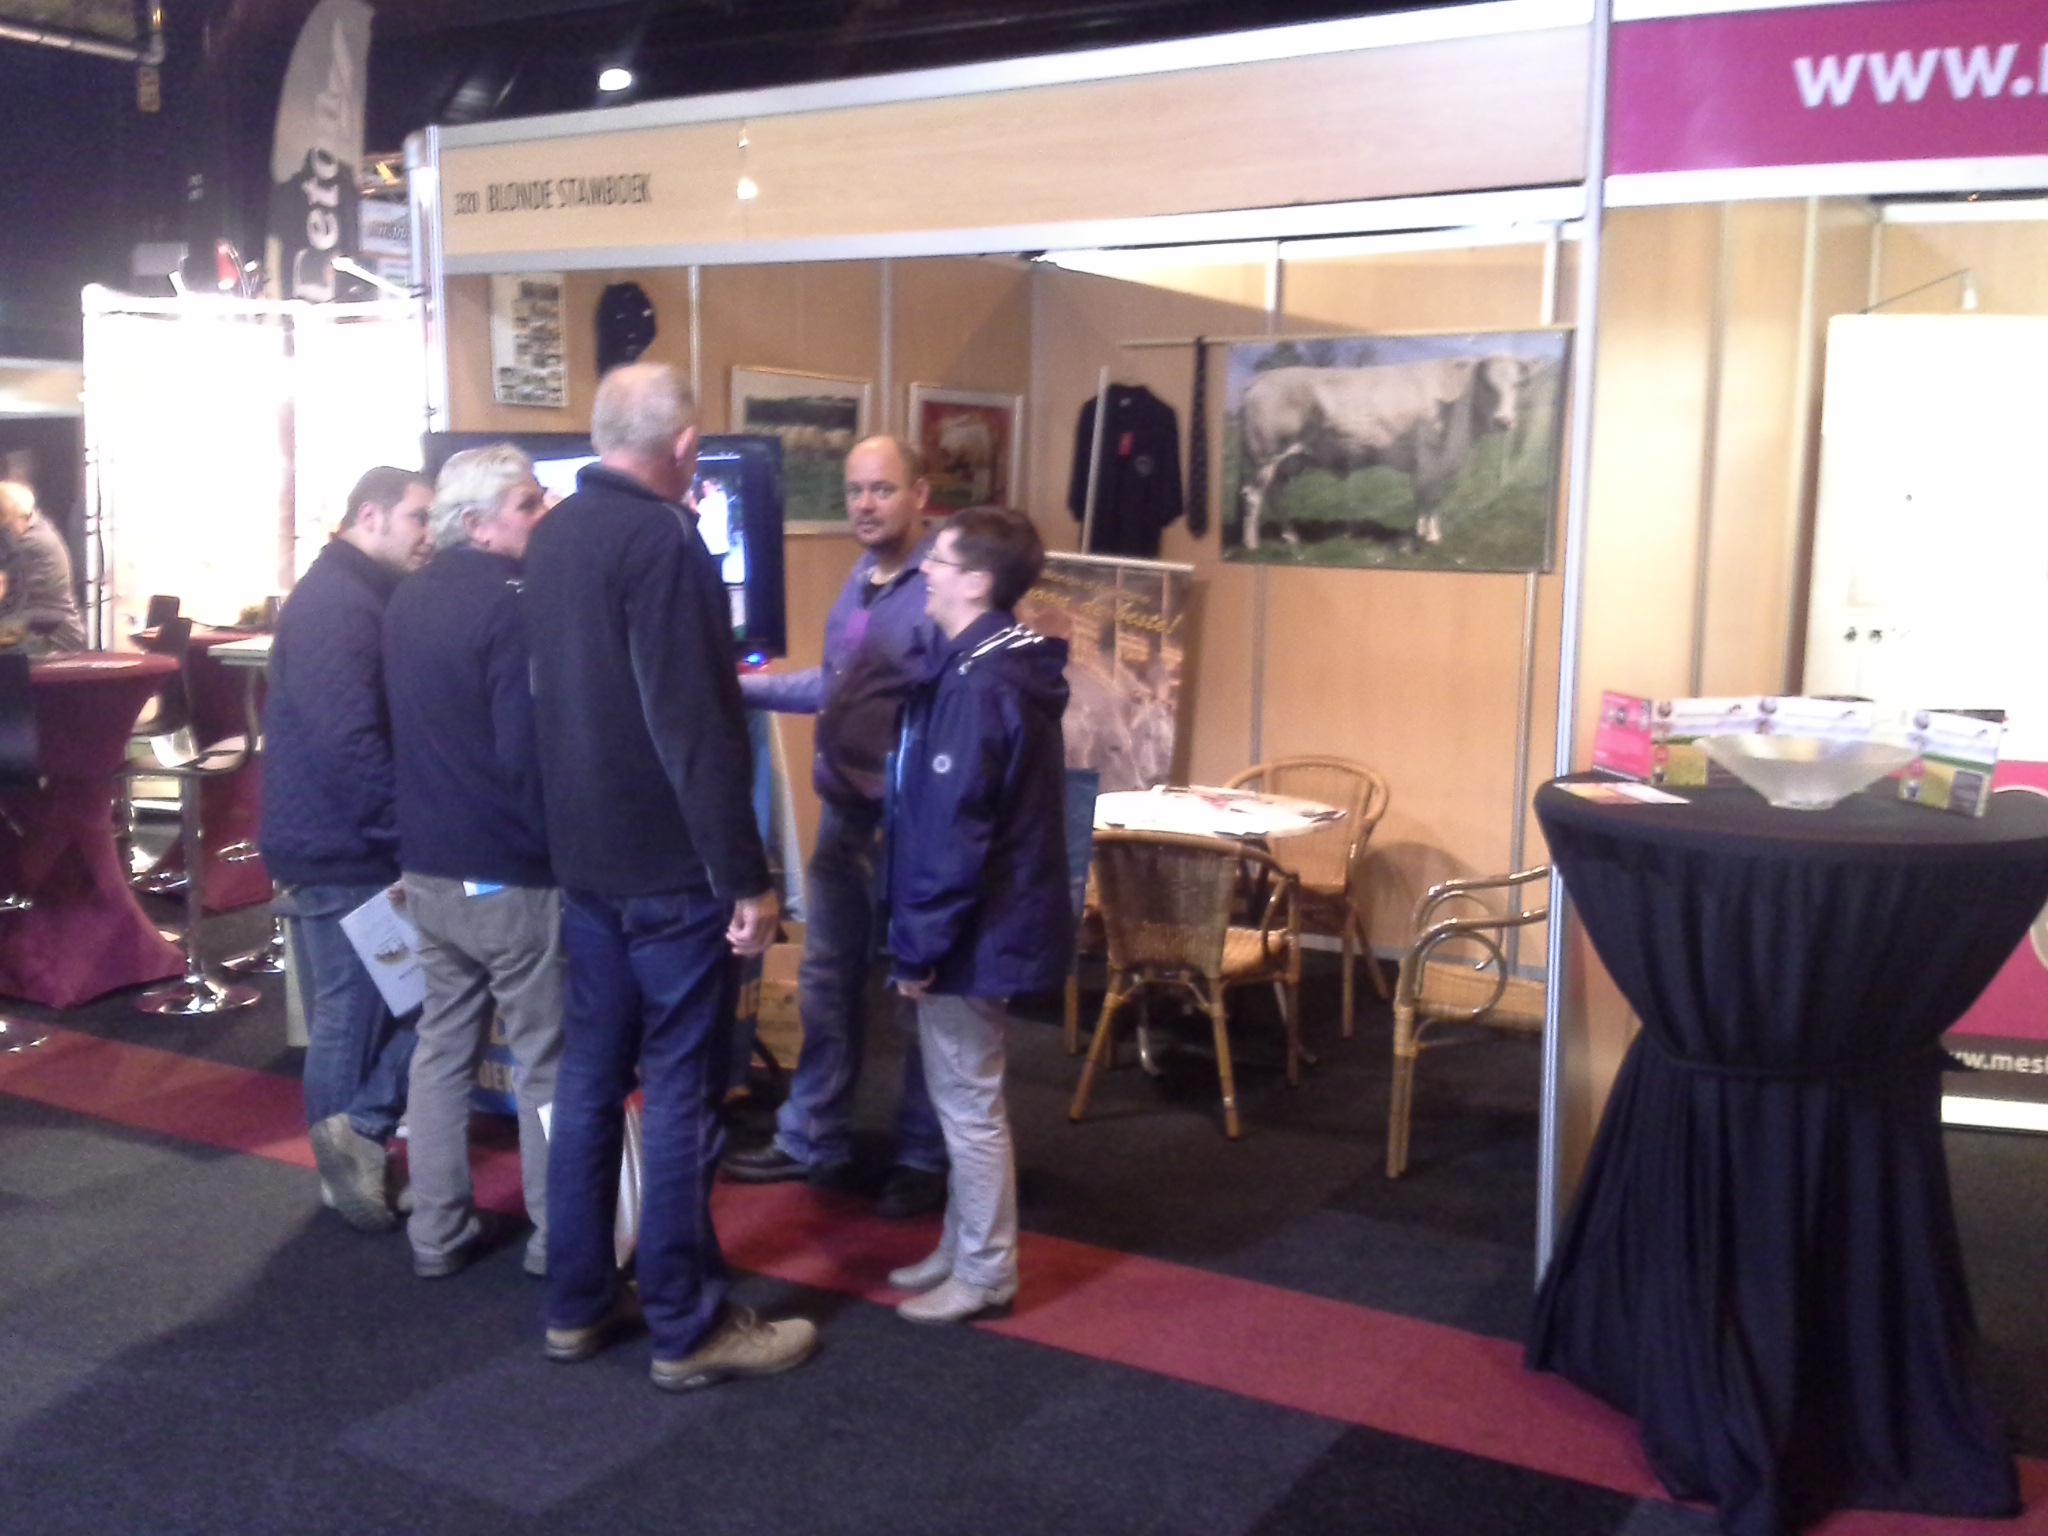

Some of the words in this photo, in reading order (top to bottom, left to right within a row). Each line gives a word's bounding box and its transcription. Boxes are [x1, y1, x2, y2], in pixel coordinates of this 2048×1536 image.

[1793, 42, 2048, 108] www.
[486, 179, 552, 212] BLONDE
[556, 173, 651, 207] STAMBOEK
